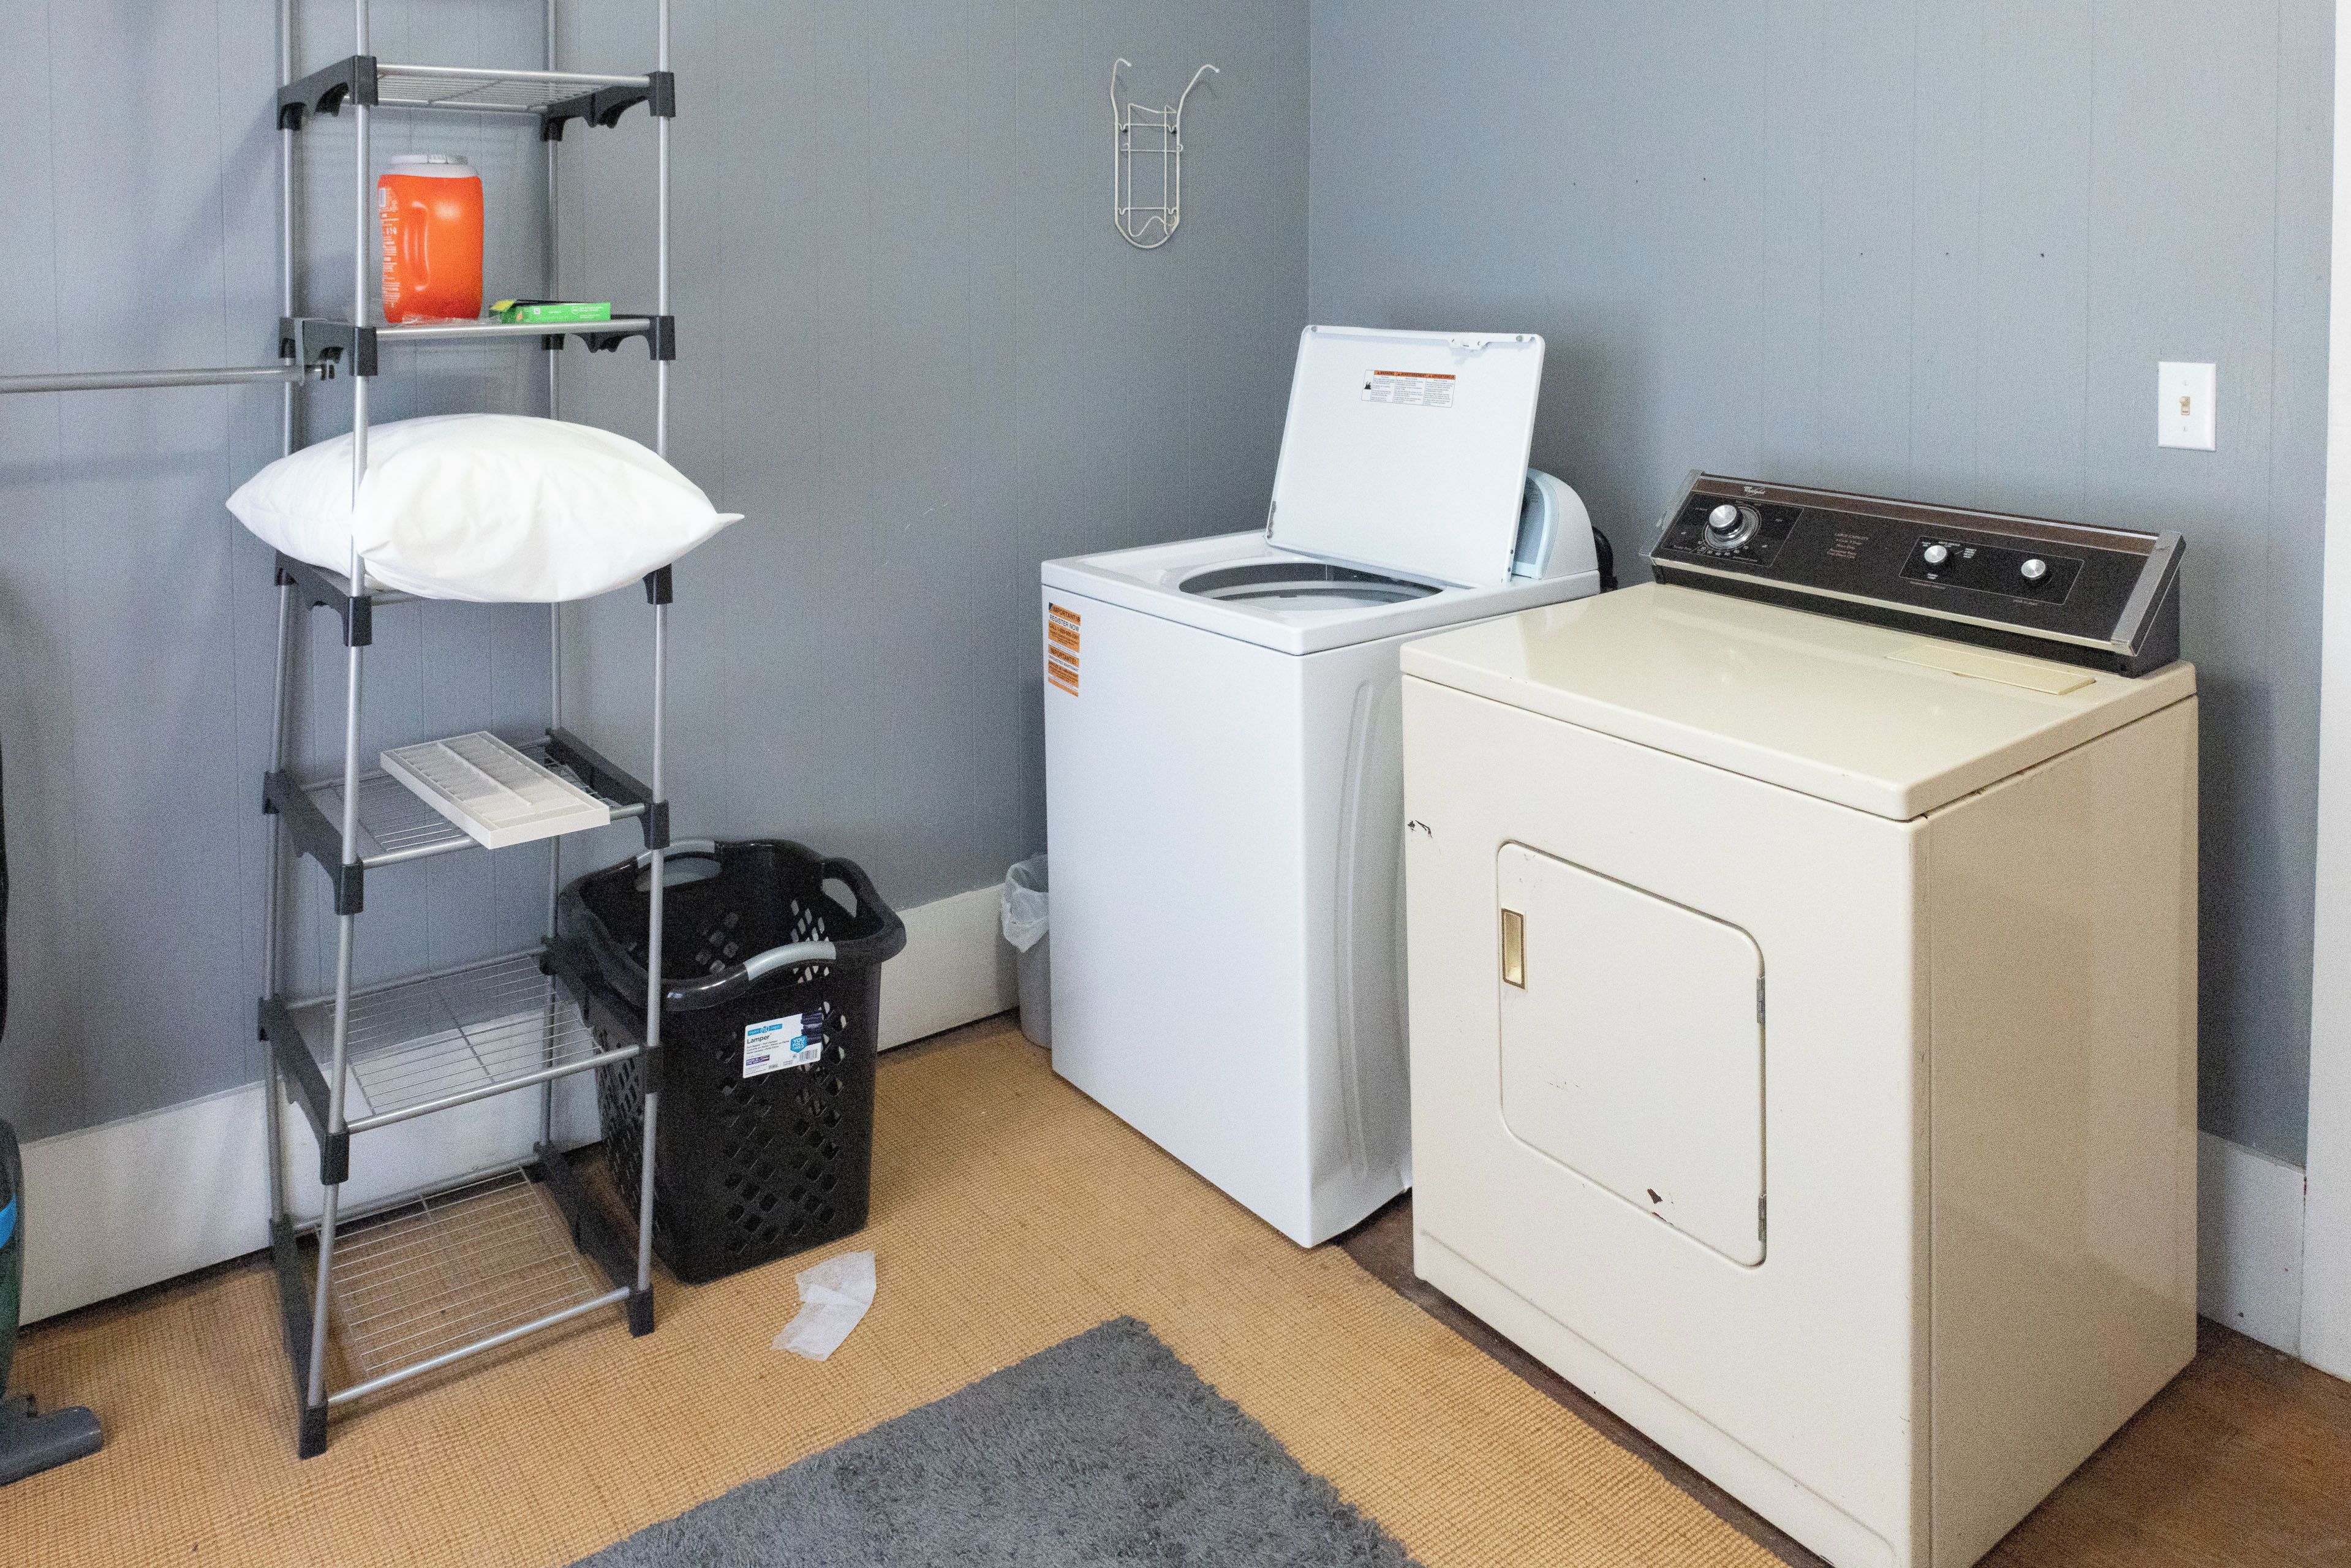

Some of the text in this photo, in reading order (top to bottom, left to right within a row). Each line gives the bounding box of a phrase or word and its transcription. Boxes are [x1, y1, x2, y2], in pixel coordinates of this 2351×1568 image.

[1743, 486, 1765, 497] Whirlpool
[1049, 614, 1079, 632] REGISTER NOW
[747, 1035, 770, 1044] Lamper
